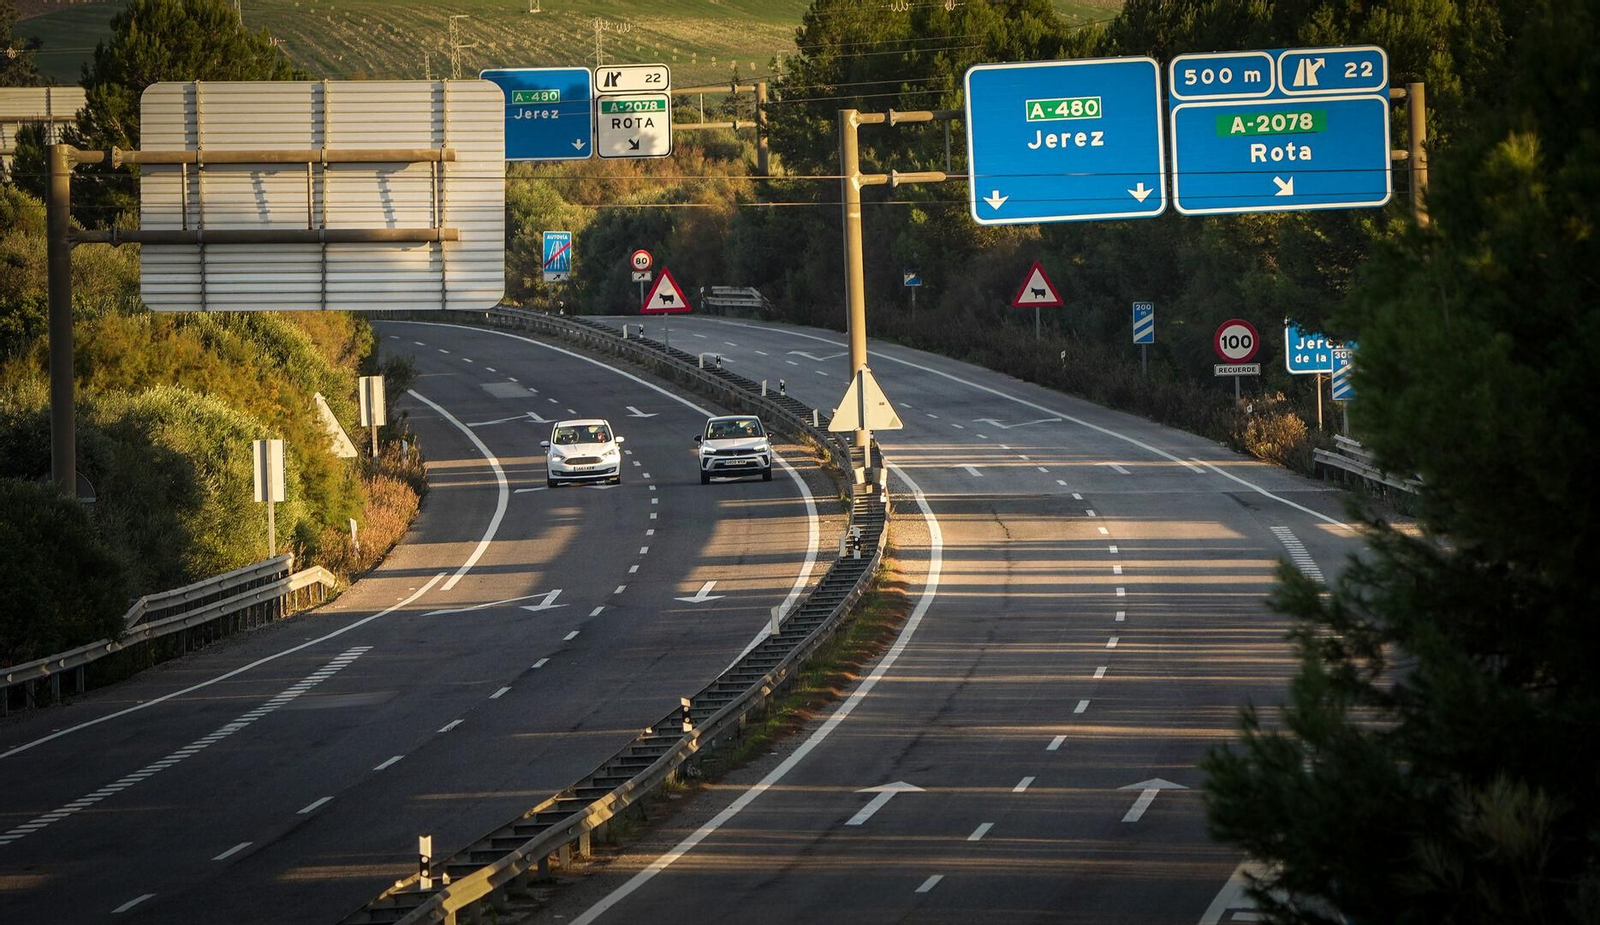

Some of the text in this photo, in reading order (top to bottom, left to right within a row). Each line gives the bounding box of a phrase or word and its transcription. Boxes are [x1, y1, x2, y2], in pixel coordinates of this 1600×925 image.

[1344, 61, 1374, 79] 22
[645, 73, 661, 83] 22
[1184, 67, 1262, 86] 500 m
[514, 91, 558, 103] A-480
[609, 101, 659, 113] A-2078
[1029, 99, 1099, 119] A-480
[514, 108, 559, 119] Jerez
[611, 117, 655, 129] ROTA
[1229, 112, 1314, 134] A-2078
[1027, 129, 1105, 150] Jerez
[1250, 141, 1313, 163] Rota
[635, 257, 648, 265] 80
[1135, 303, 1151, 311] 200
[1221, 335, 1252, 350] 100
[1295, 353, 1327, 363] de la
[1218, 366, 1256, 374] RECUERDE
